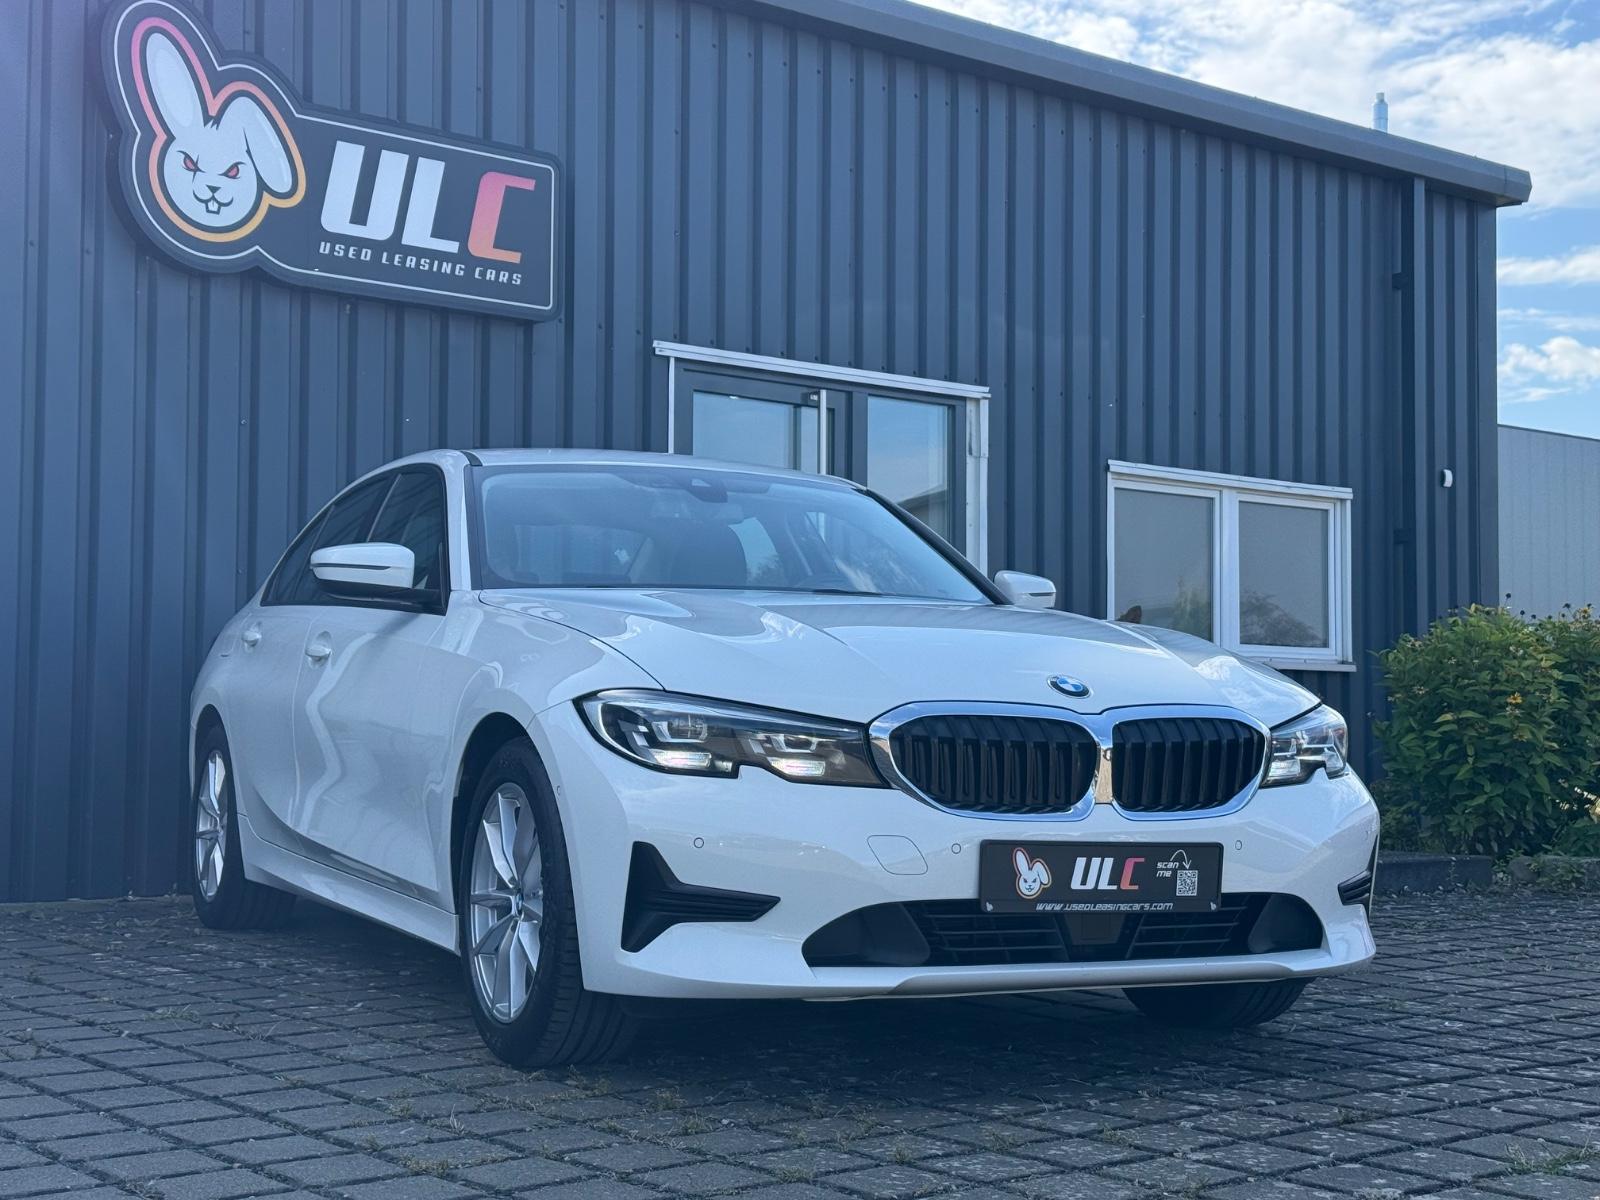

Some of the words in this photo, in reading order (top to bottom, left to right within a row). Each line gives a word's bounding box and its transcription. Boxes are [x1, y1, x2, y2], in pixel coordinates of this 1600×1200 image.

[320, 140, 536, 264] ULC
[319, 241, 372, 261] USED
[381, 251, 465, 276] LEASING
[474, 267, 522, 285] CARS
[1070, 856, 1145, 890] ULC
[1156, 861, 1180, 869] scan
